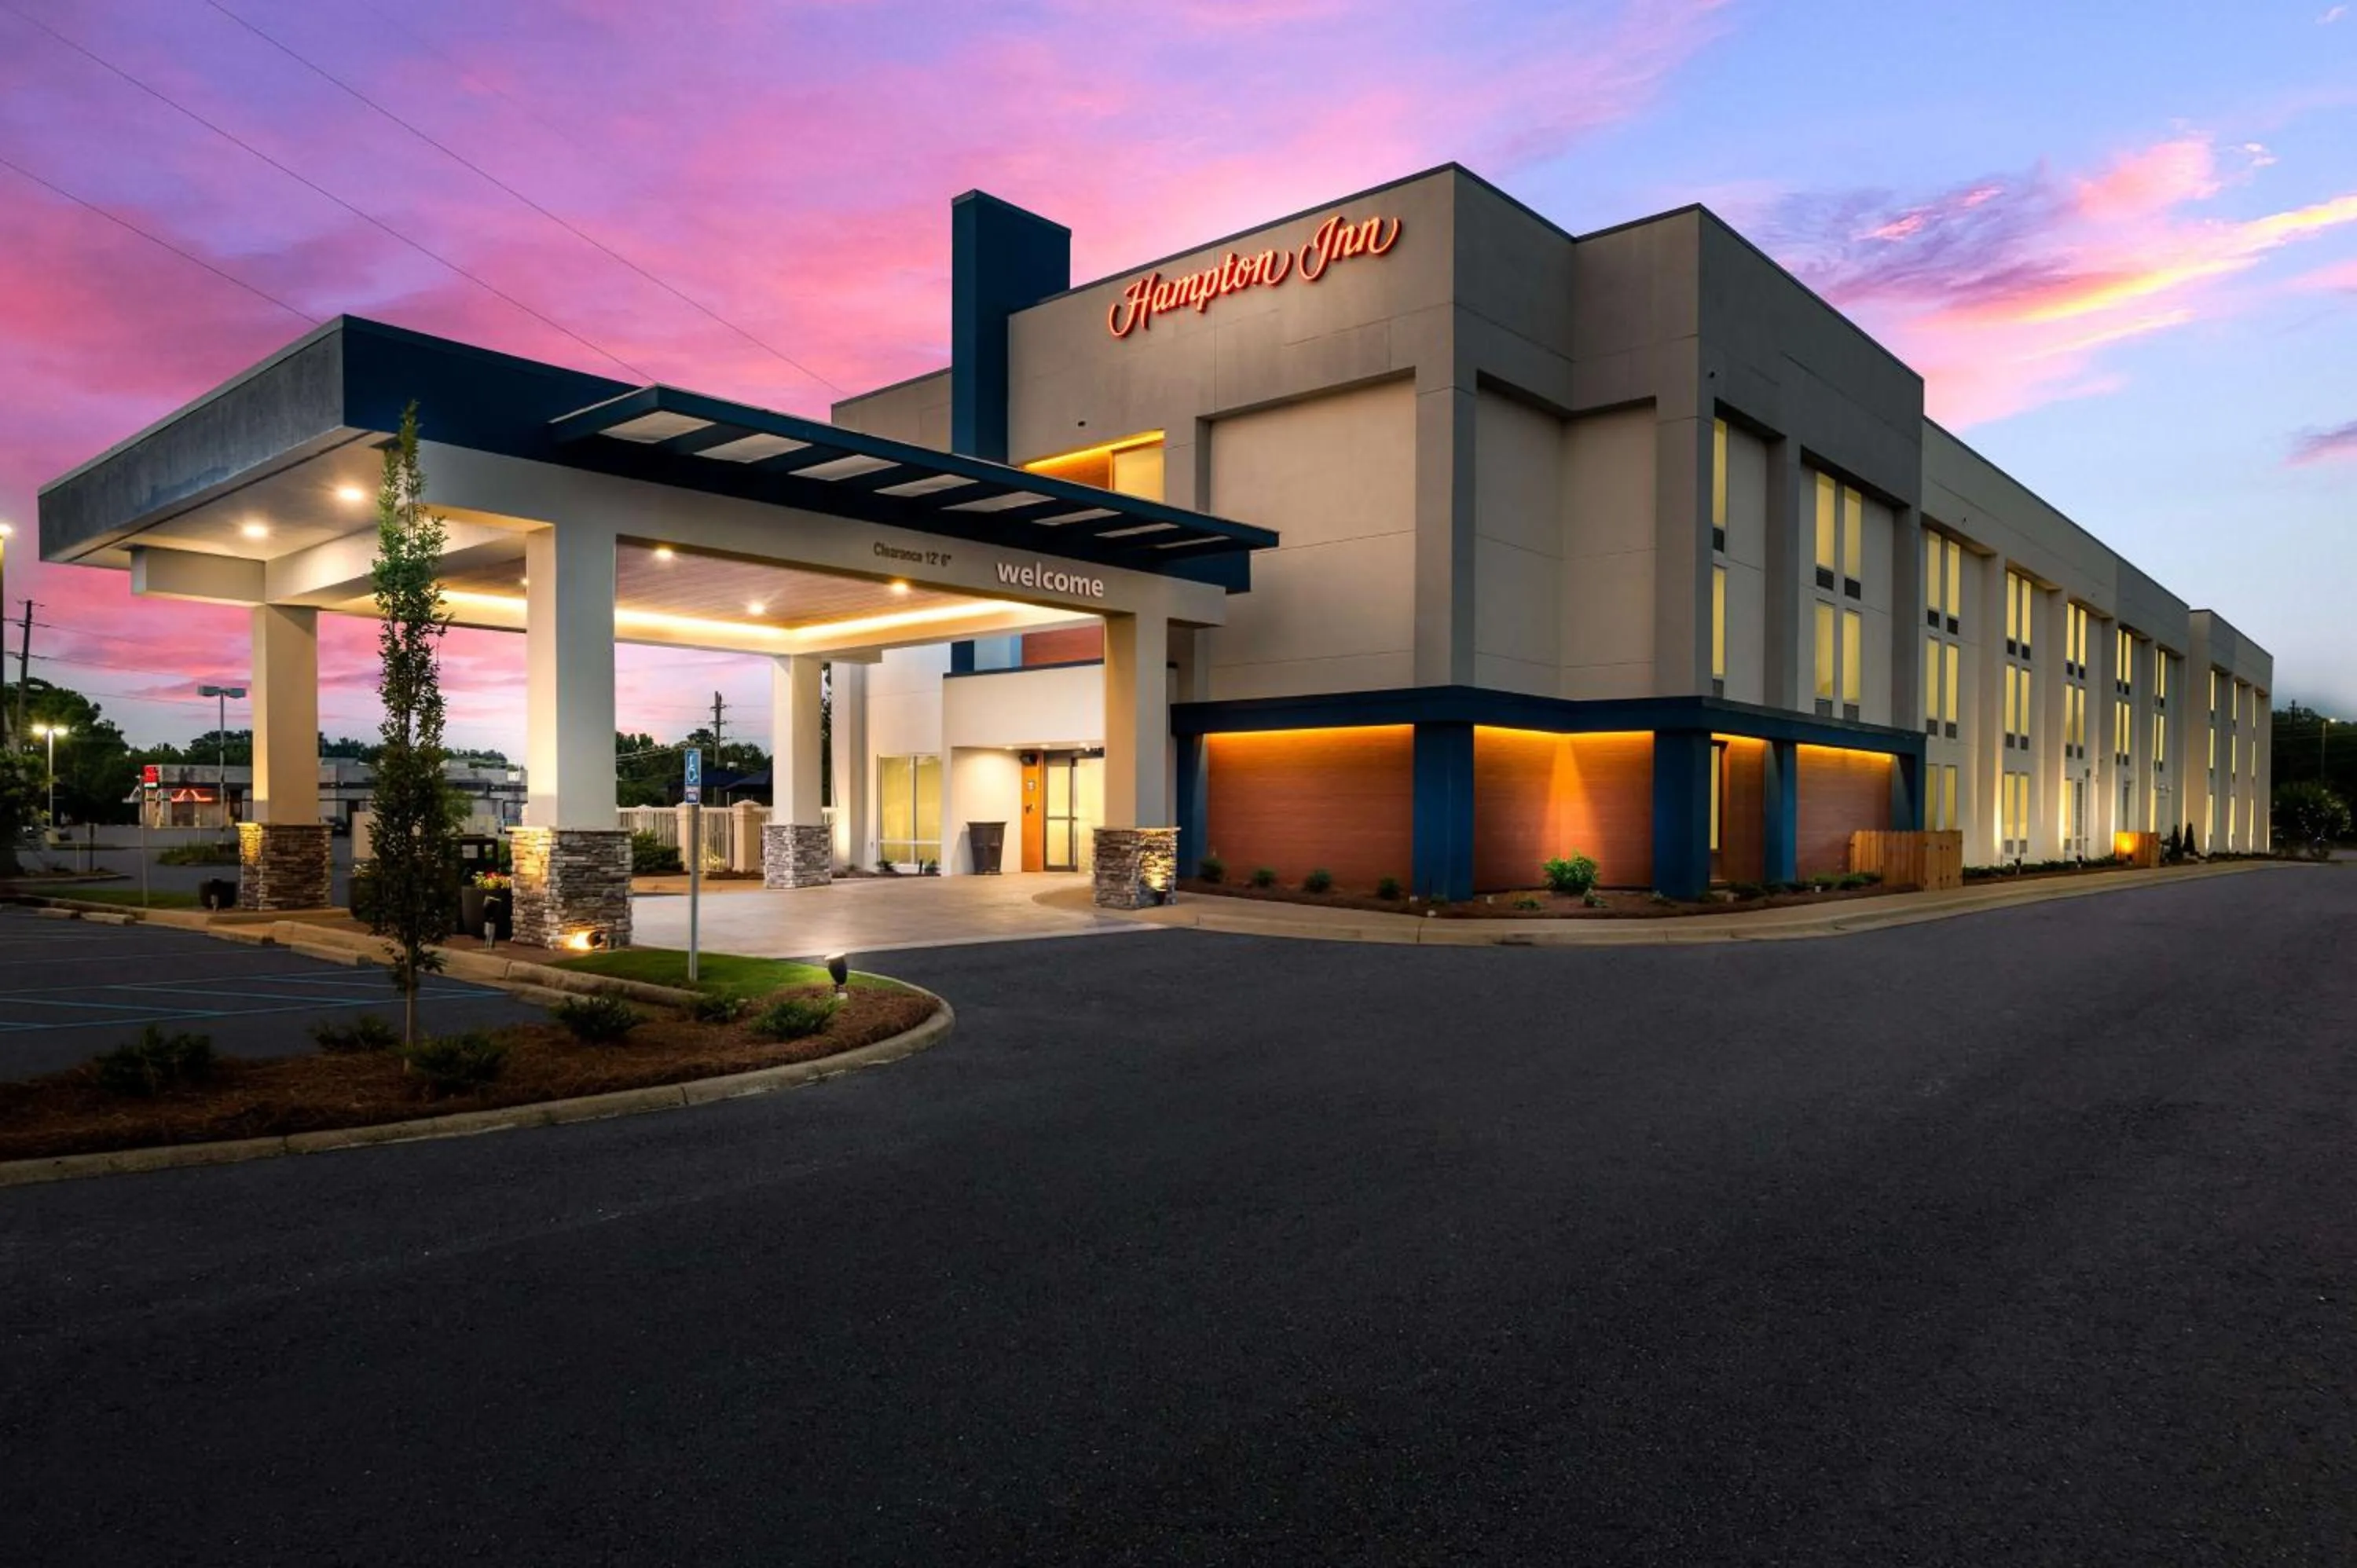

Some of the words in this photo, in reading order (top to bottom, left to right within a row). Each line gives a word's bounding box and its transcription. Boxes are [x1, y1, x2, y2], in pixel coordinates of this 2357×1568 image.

[1109, 250, 1293, 338] Hampton
[1298, 216, 1402, 281] Inn
[874, 542, 922, 562] Clearance
[995, 561, 1104, 597] welcome
